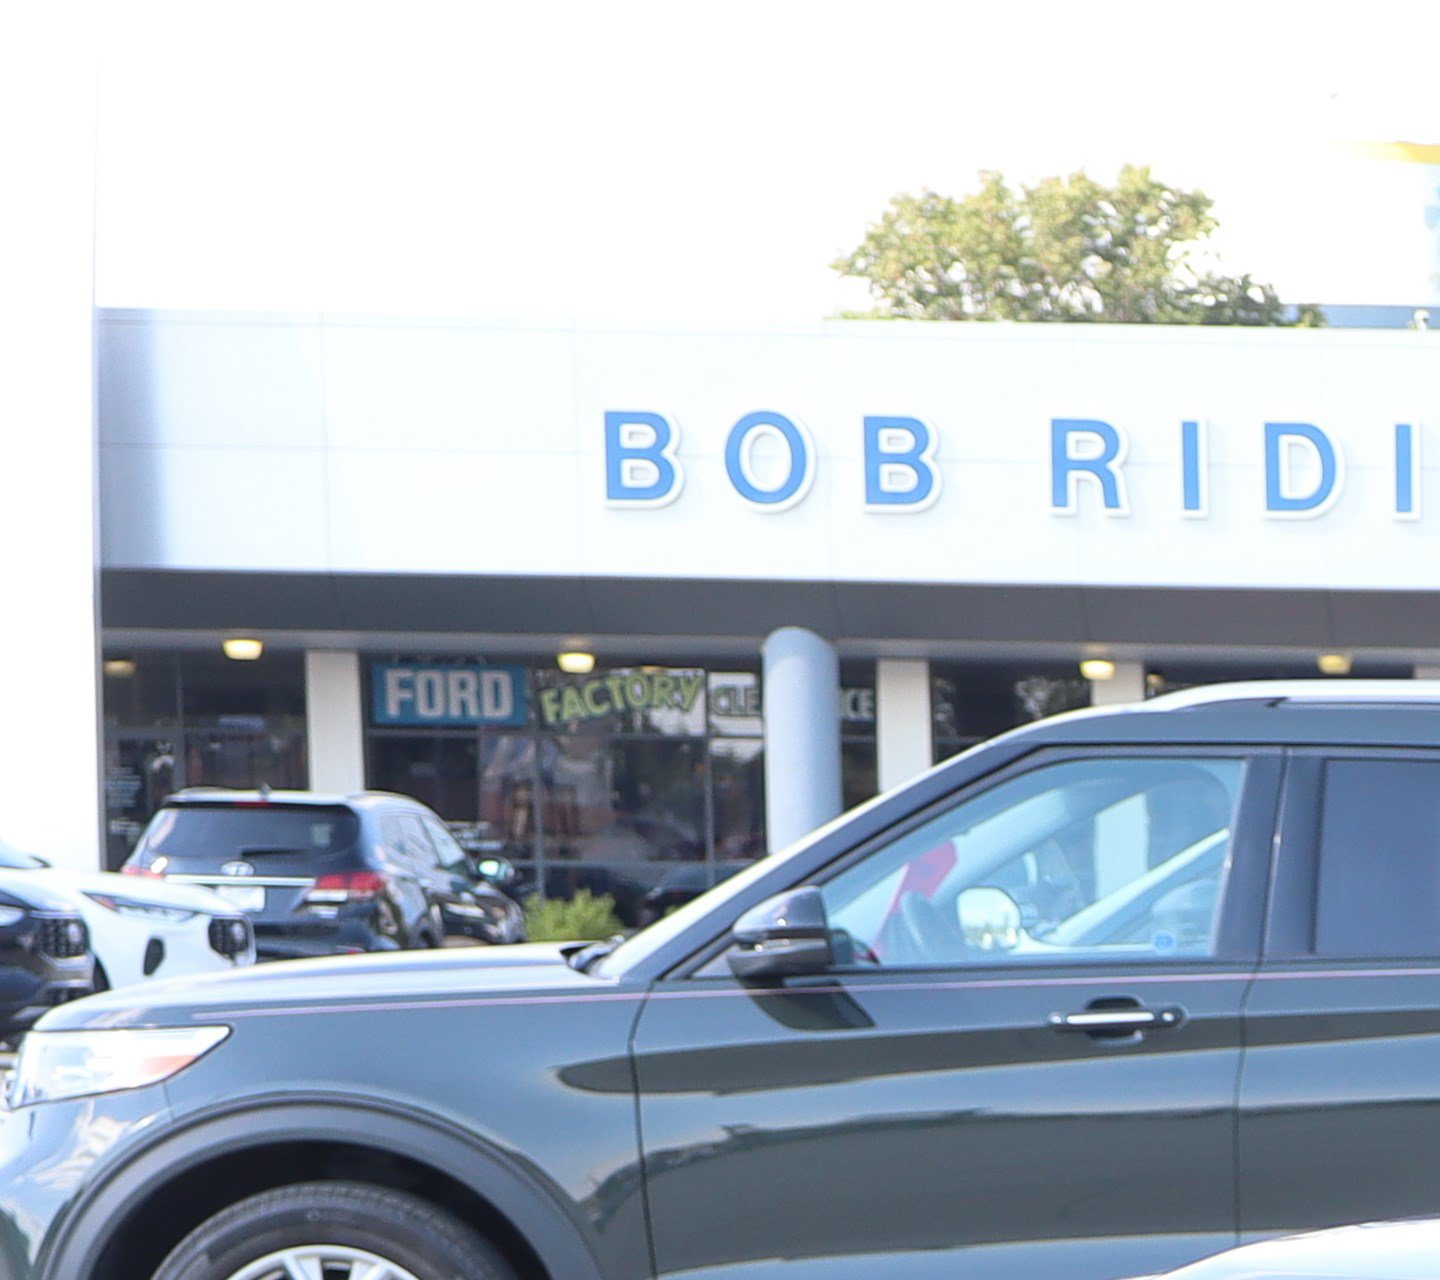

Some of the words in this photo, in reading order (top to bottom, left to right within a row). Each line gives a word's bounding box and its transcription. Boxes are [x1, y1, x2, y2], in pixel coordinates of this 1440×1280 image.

[604, 410, 940, 509] BOB
[384, 668, 513, 719] FORD
[541, 674, 700, 724] FACTORY
